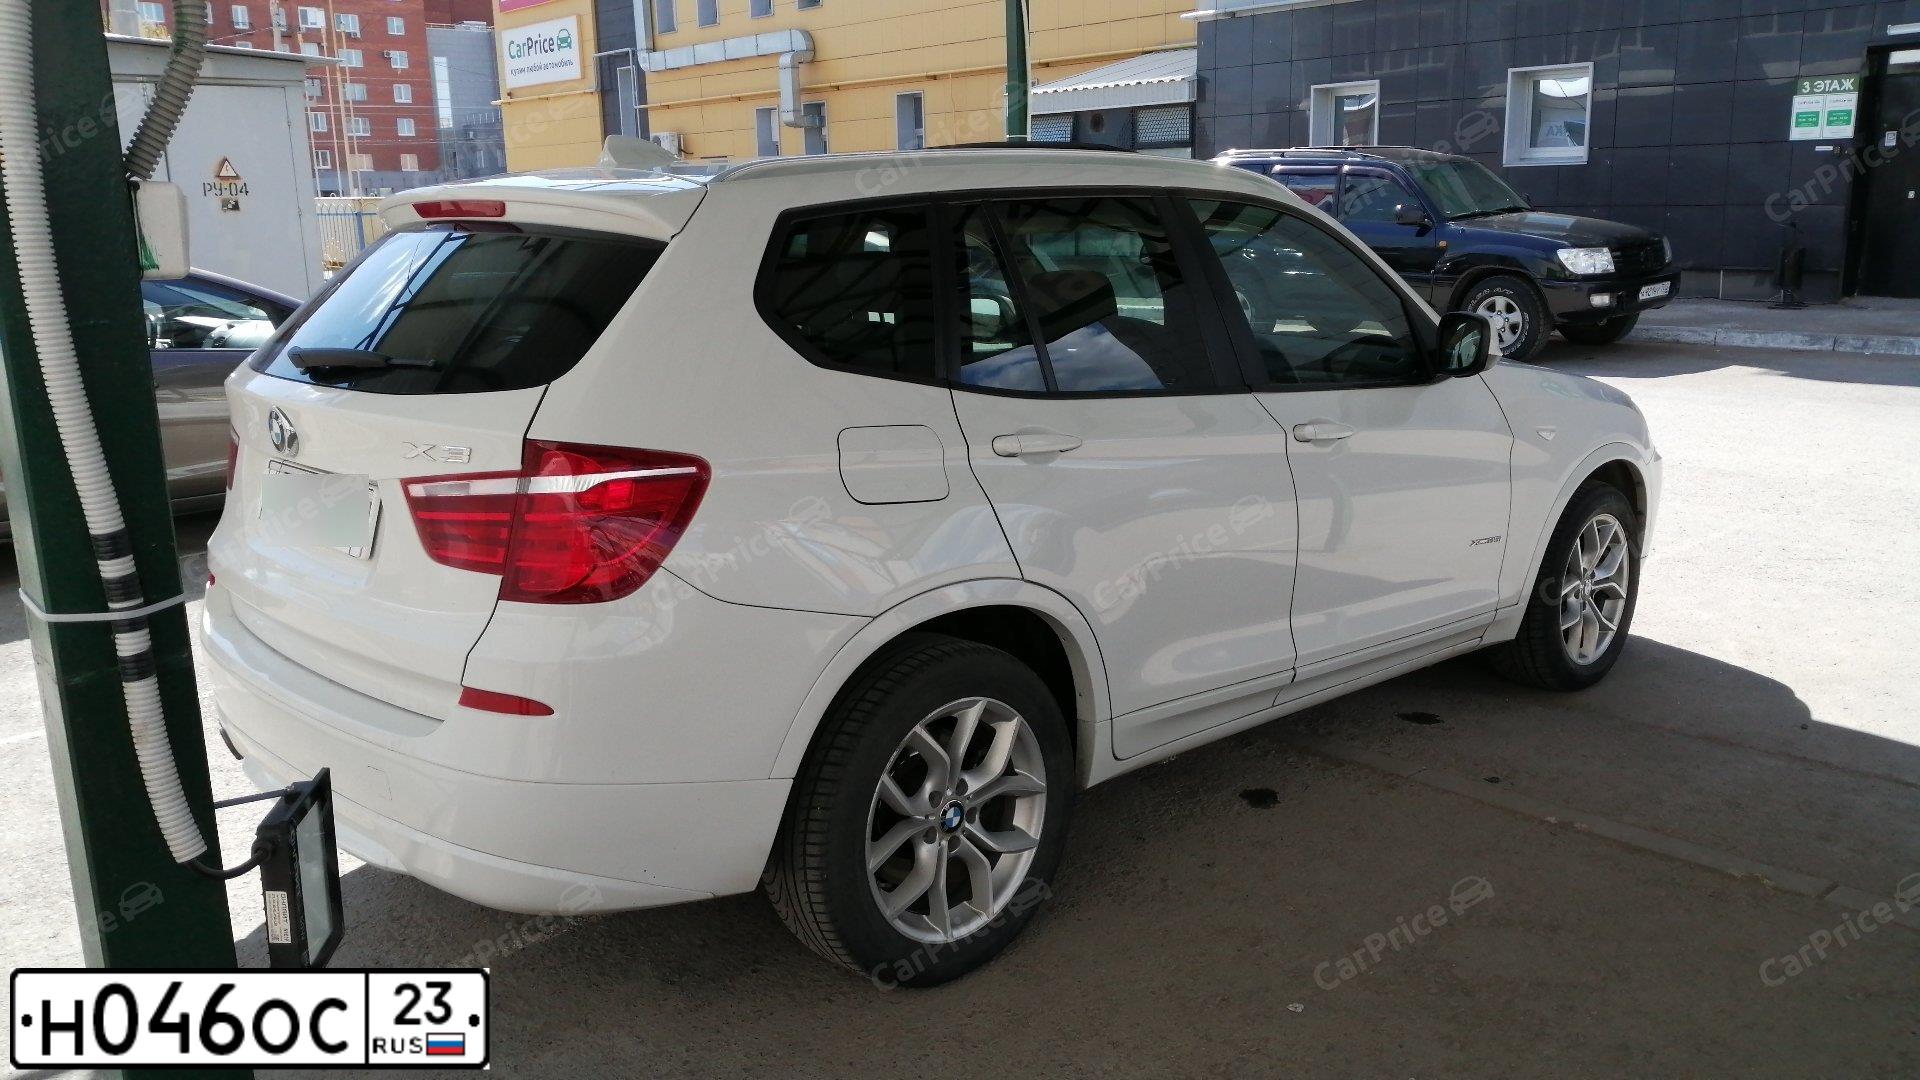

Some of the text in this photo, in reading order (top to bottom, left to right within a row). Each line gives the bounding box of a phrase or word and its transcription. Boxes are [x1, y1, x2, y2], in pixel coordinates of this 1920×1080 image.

[508, 33, 555, 59] CarPrice
[1802, 78, 1855, 93] 3 ЭТАЖ
[202, 182, 249, 197] РУ-04
[401, 441, 472, 464] X3
